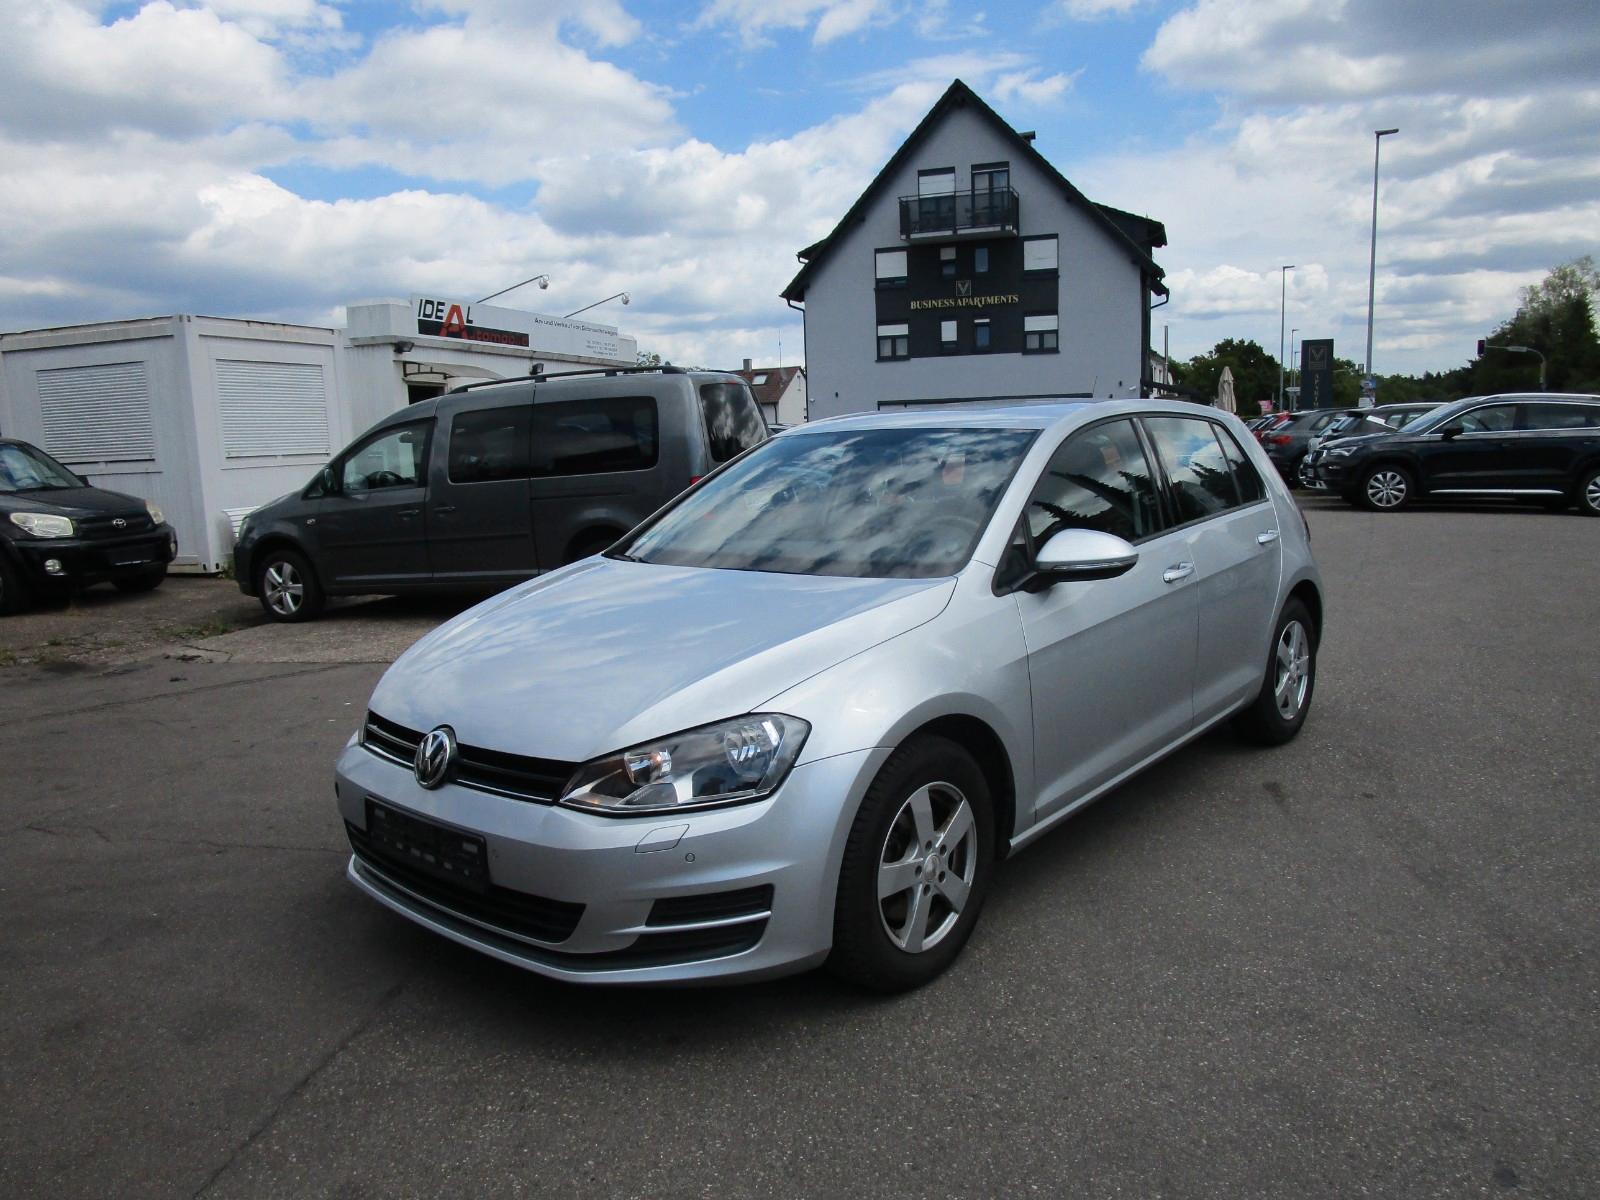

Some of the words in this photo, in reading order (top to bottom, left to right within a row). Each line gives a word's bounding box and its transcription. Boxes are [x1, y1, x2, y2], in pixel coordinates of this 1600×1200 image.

[910, 297, 955, 310] BUSINESS
[957, 295, 1018, 308] APARTMENTS
[418, 299, 473, 339] IDEAL
